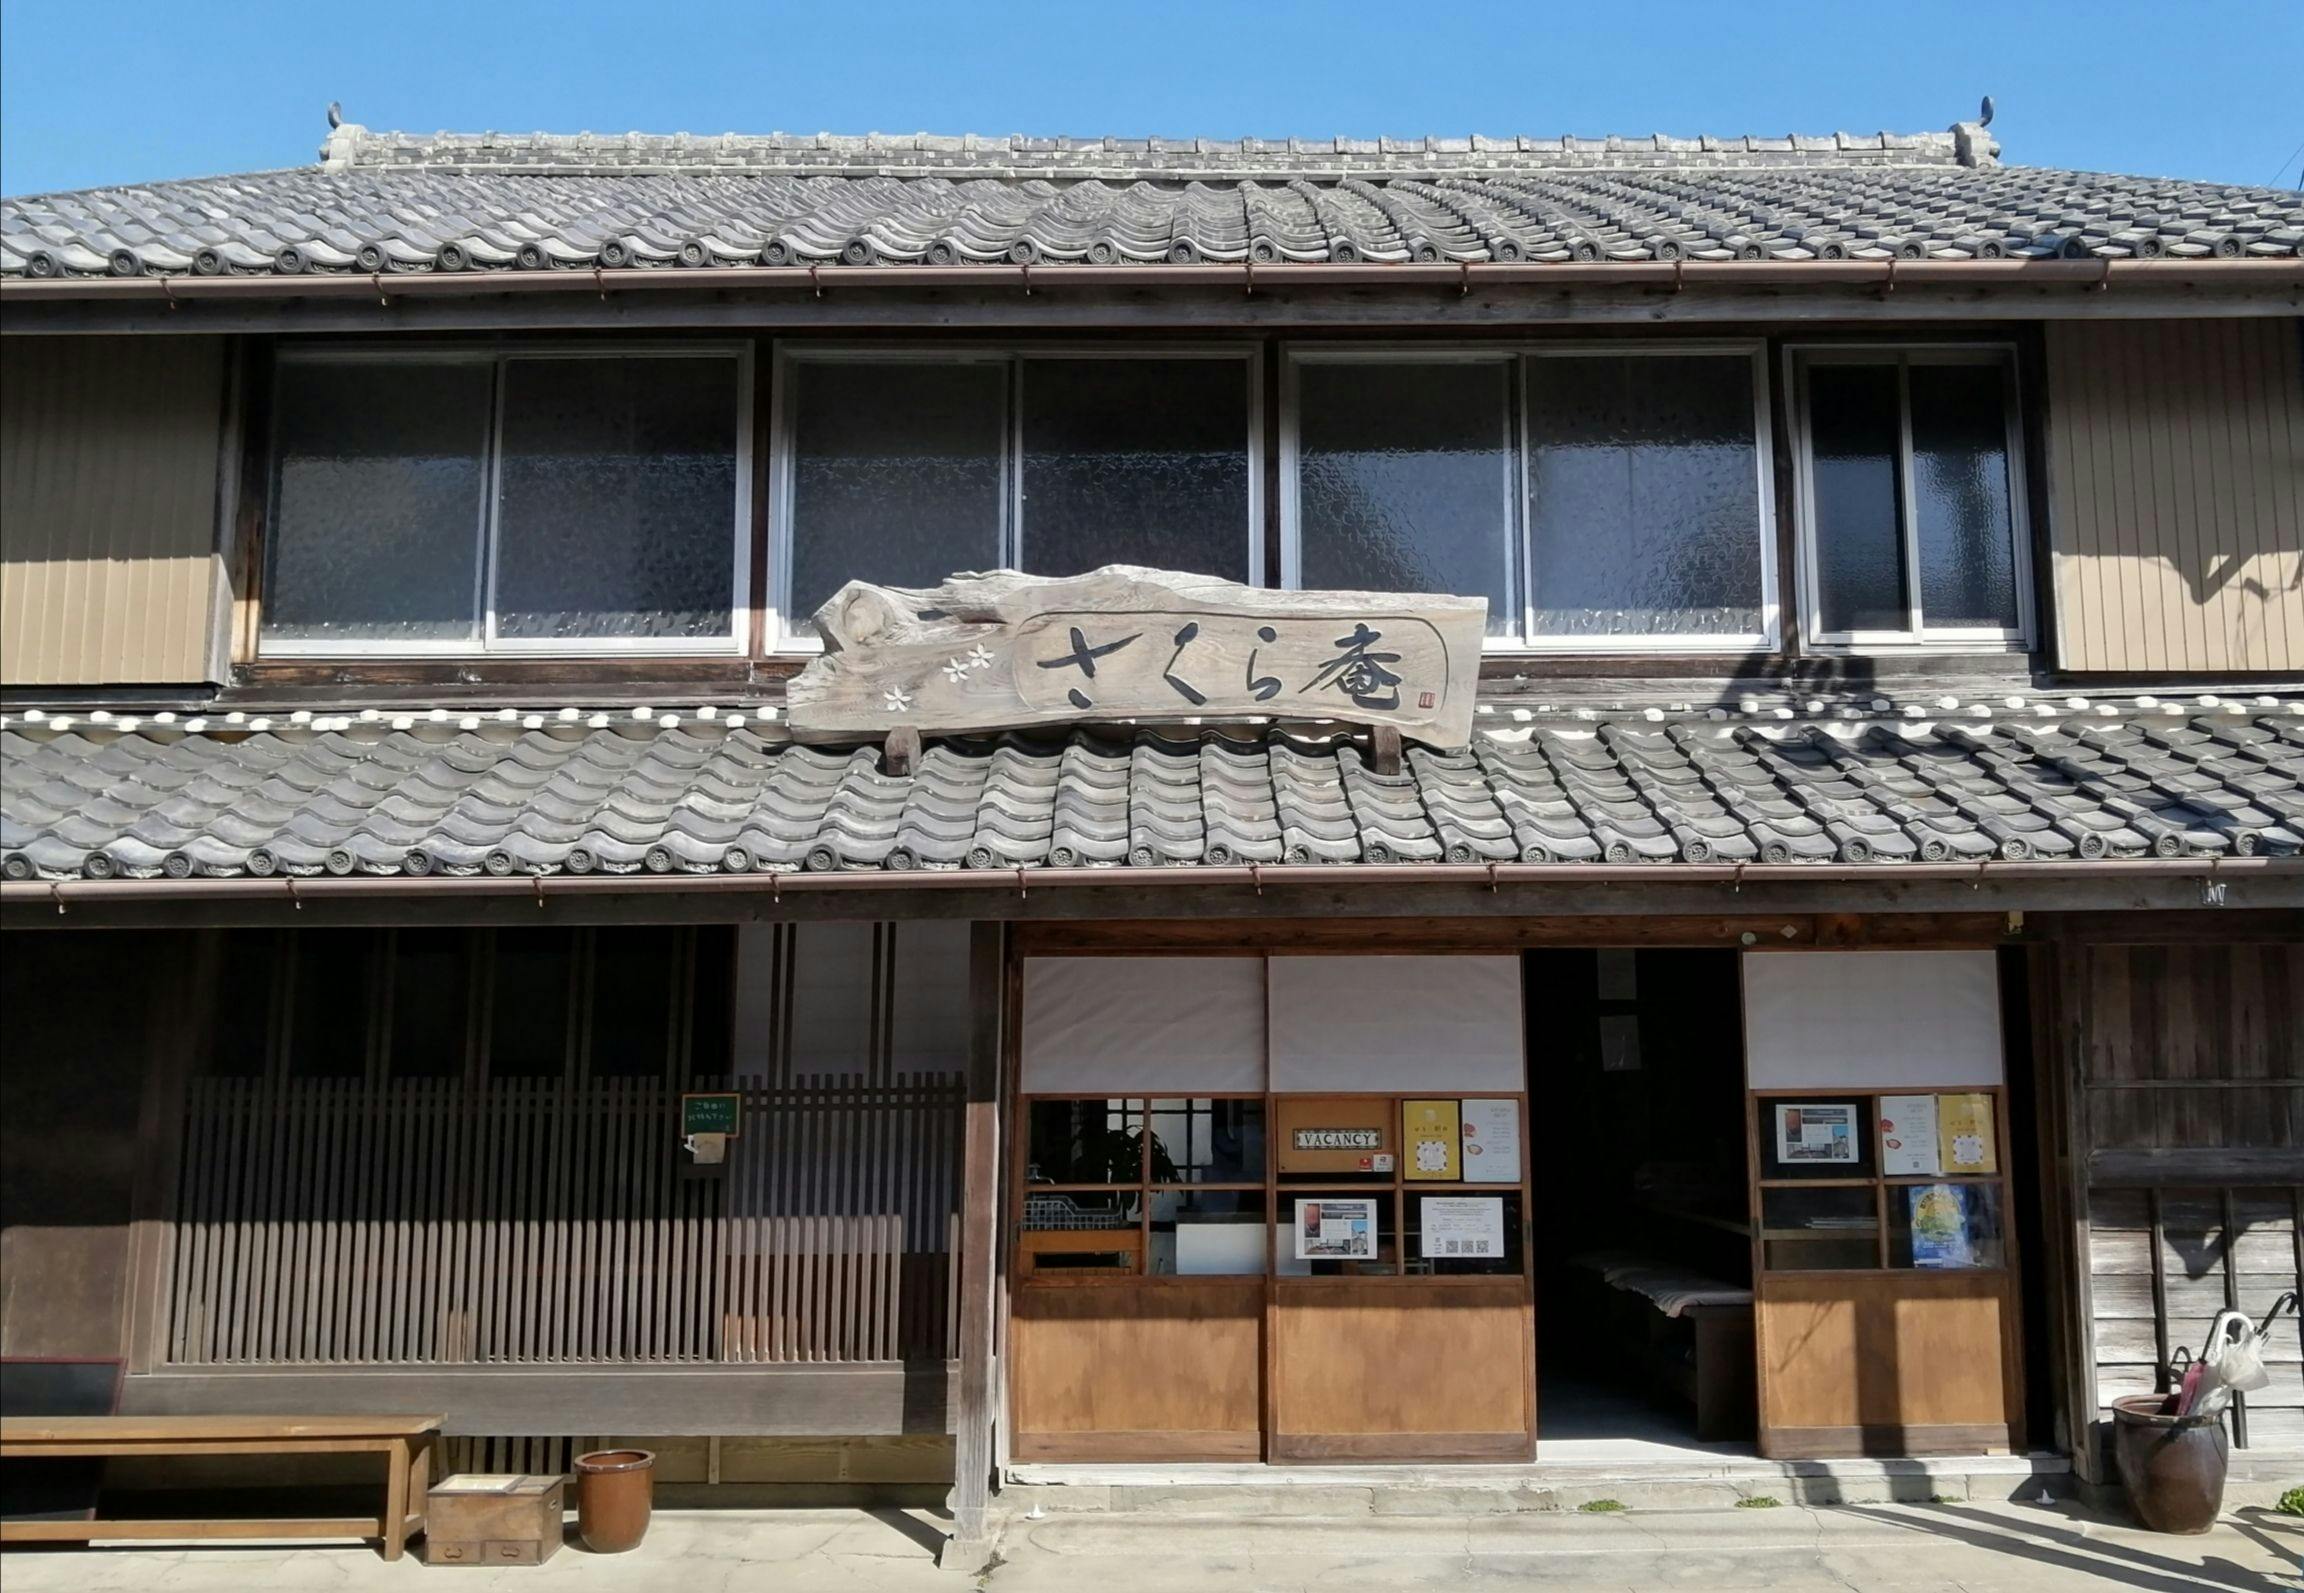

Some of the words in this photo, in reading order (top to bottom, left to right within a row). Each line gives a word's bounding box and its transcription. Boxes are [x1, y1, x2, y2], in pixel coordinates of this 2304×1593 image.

[1036, 622, 1402, 711] さくら庵
[1304, 1134, 1372, 1146] VACANCY
